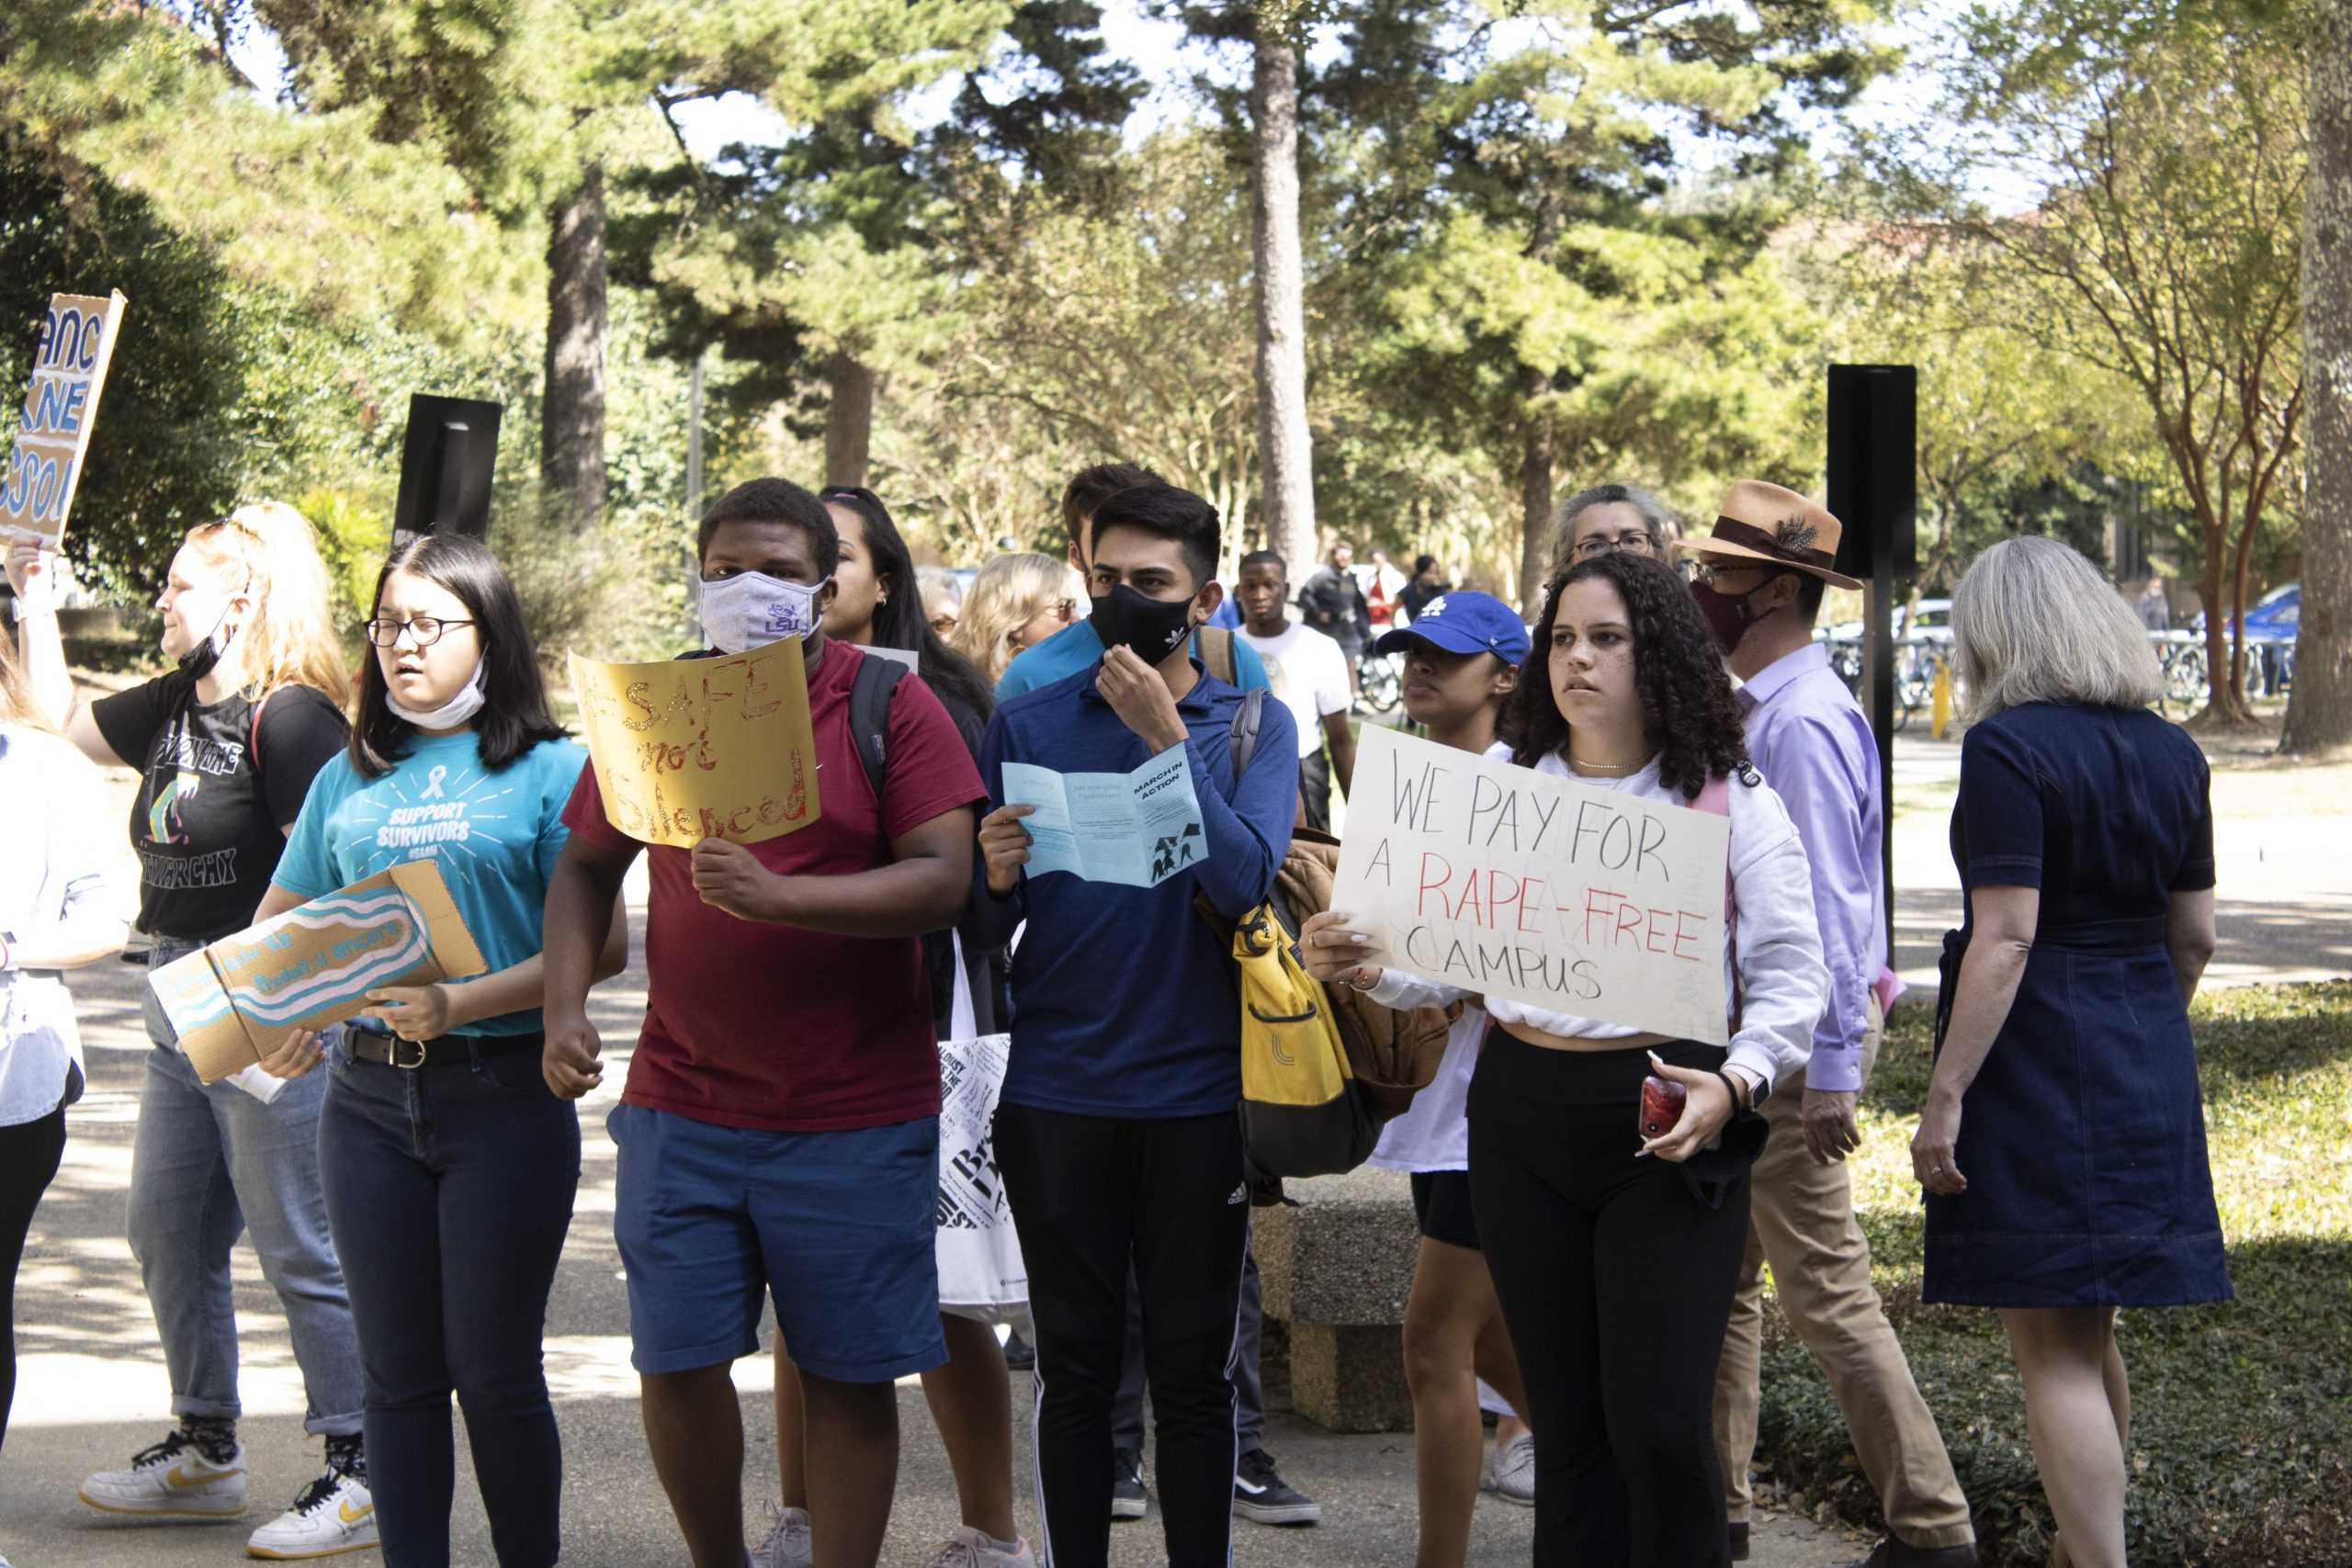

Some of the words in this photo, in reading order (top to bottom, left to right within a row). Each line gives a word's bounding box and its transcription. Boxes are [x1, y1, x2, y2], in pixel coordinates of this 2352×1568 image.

[764, 616, 800, 633] LSU
[1134, 768, 1171, 795] MARCH
[1171, 761, 1183, 773] IN
[1142, 773, 1180, 800] ACTION
[388, 802, 468, 826] SUPPORT
[1392, 748, 1451, 833] WE
[1466, 774, 1561, 852] PAY
[1570, 800, 1670, 882] FOR
[377, 821, 470, 848] SURVIVORS
[1363, 837, 1391, 886] A
[1405, 925, 1603, 1000] CAMPUS
